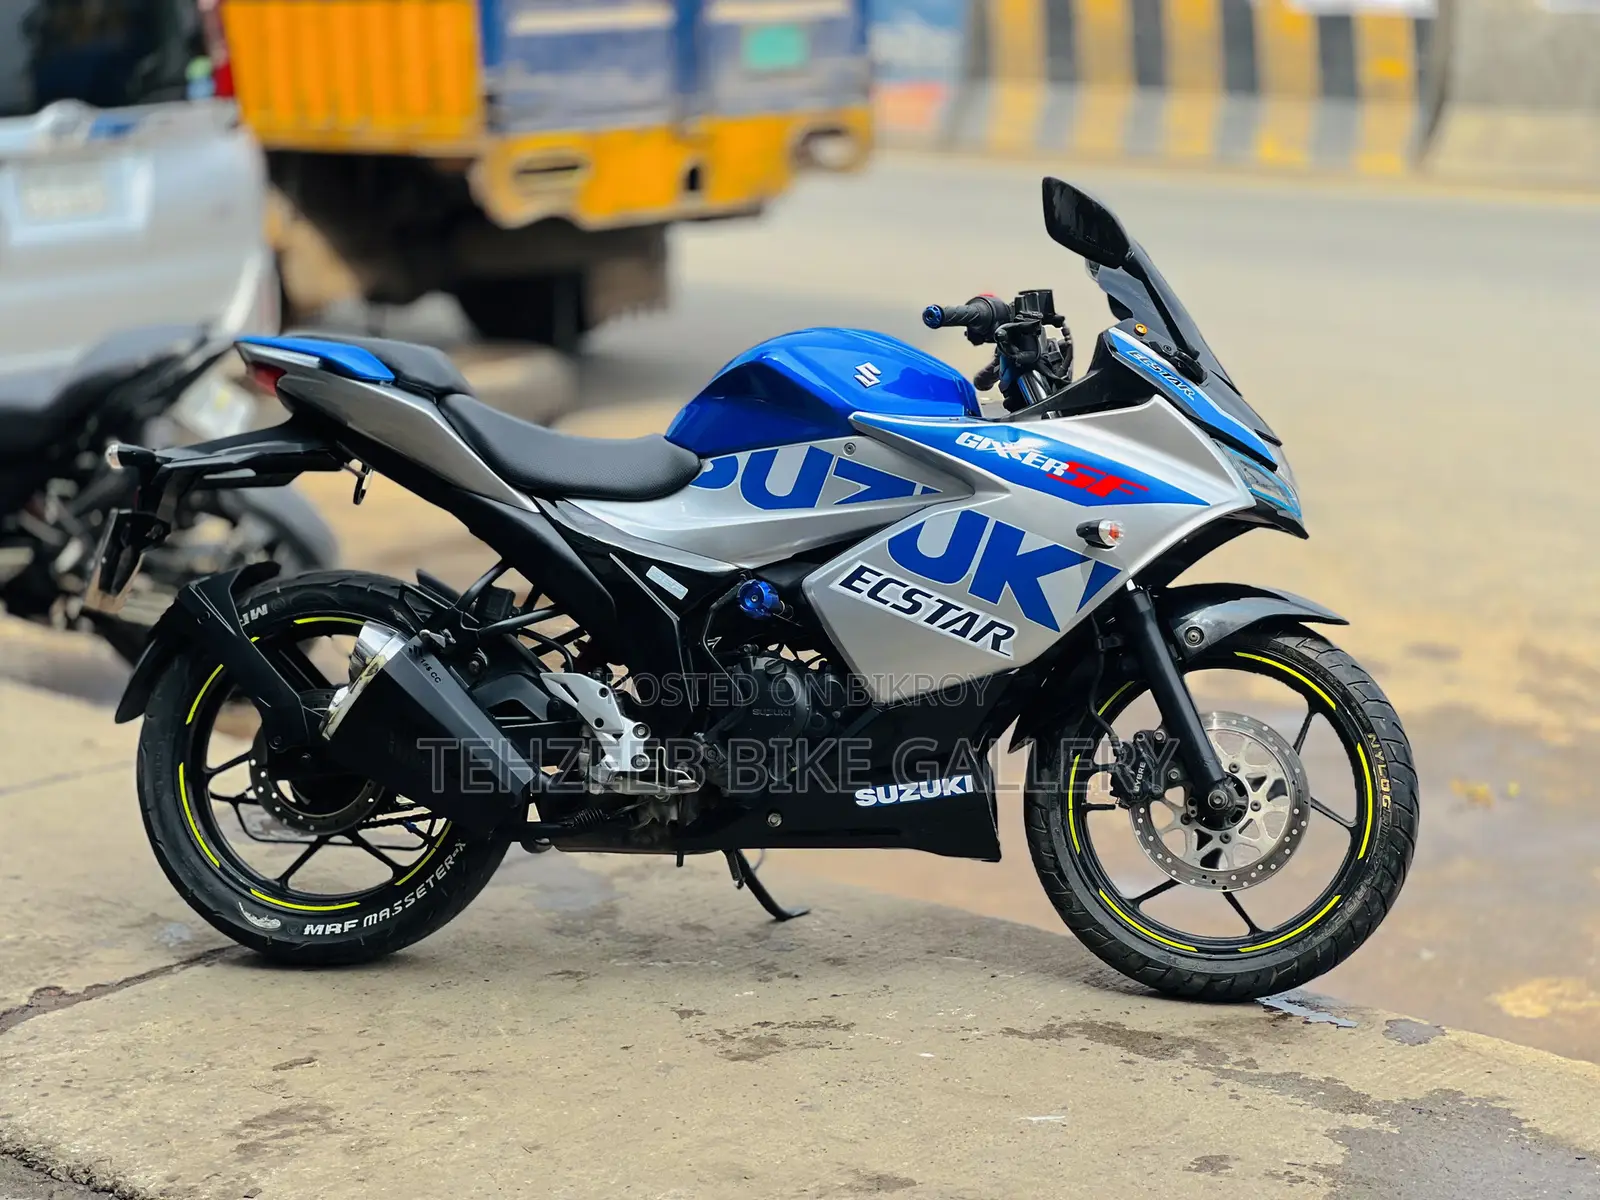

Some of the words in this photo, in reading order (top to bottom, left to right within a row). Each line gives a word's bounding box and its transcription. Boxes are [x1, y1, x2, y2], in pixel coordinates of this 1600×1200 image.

[1126, 350, 1195, 401] ECSTAR
[838, 564, 1016, 657] ECSTAR
[855, 774, 974, 807] SUZUKI
[1133, 761, 1147, 792] BYBRE
[303, 919, 360, 937] MRF
